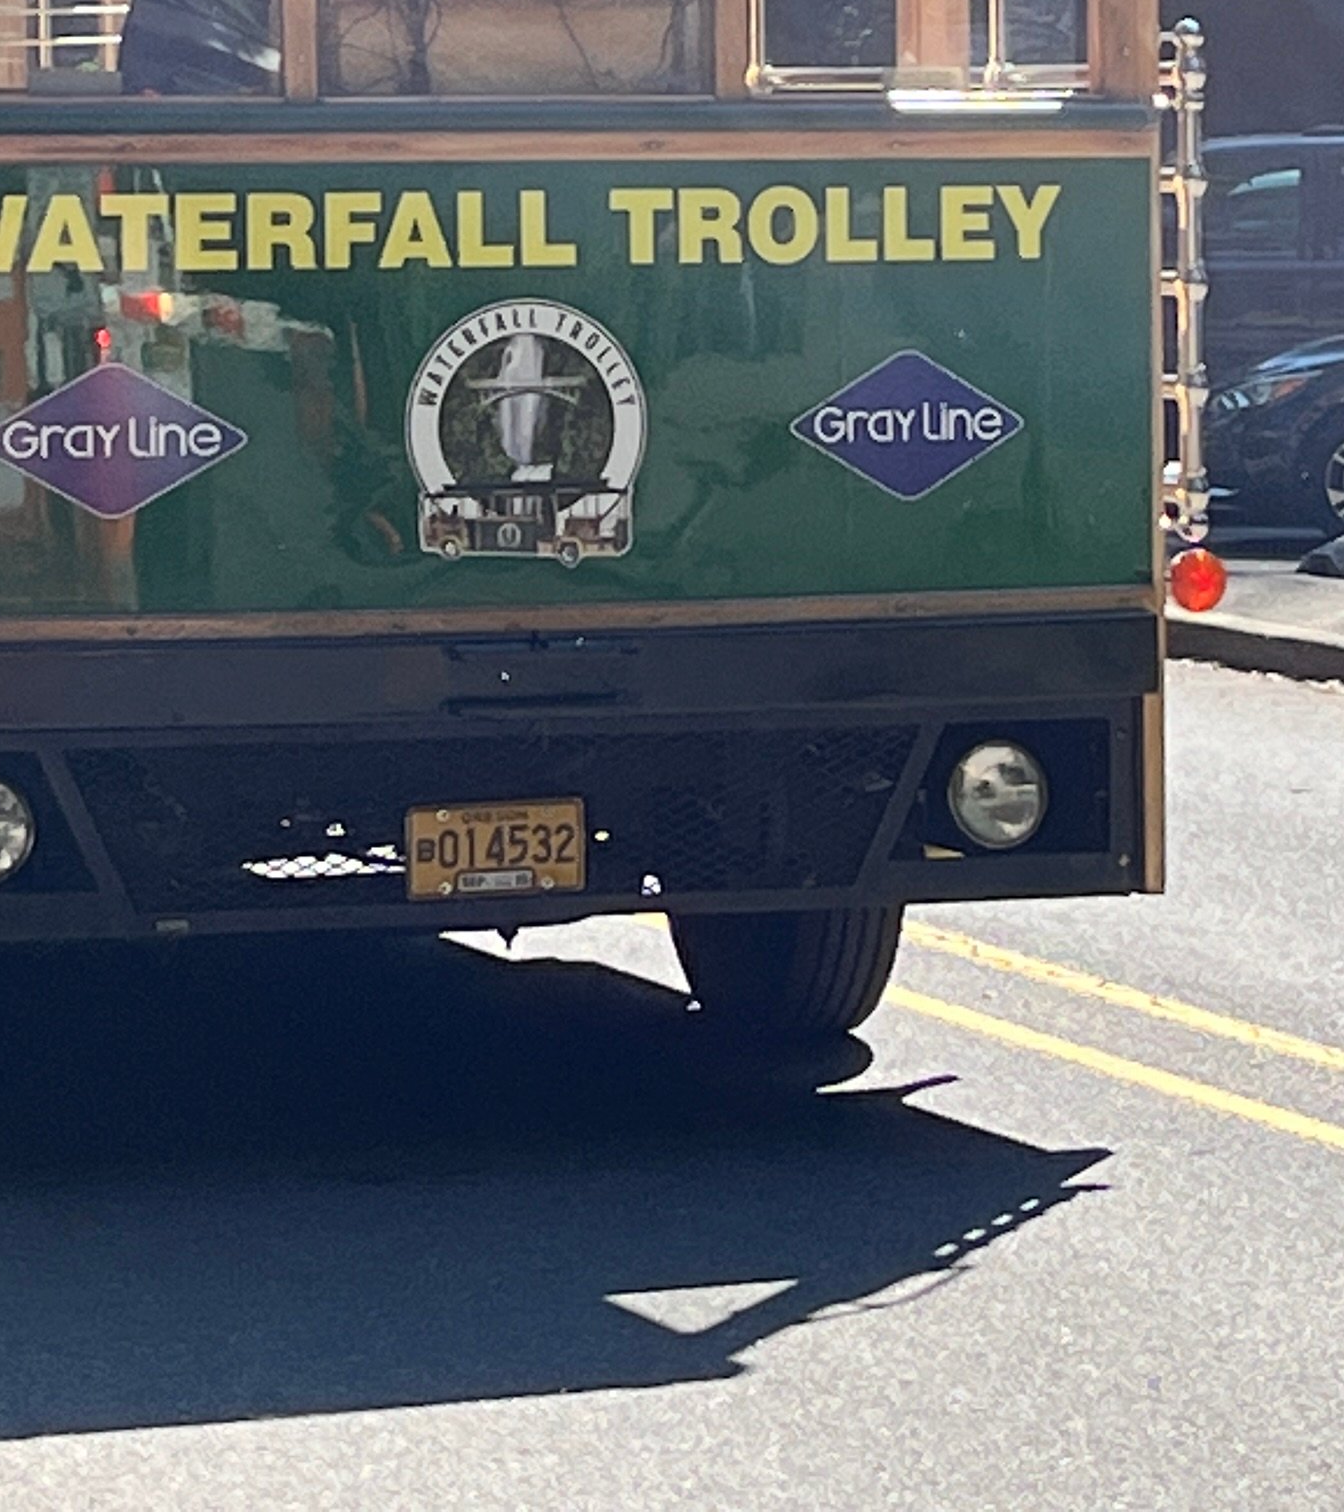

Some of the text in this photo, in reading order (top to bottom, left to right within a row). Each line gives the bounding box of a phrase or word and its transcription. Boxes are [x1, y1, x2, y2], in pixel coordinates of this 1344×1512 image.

[610, 185, 1061, 264] TROLLEY
[417, 308, 637, 406] WATERFALL TROLLEY
[2, 415, 223, 459] Gray Line
[813, 401, 1004, 443] Gray Line
[417, 823, 575, 868] B014532
